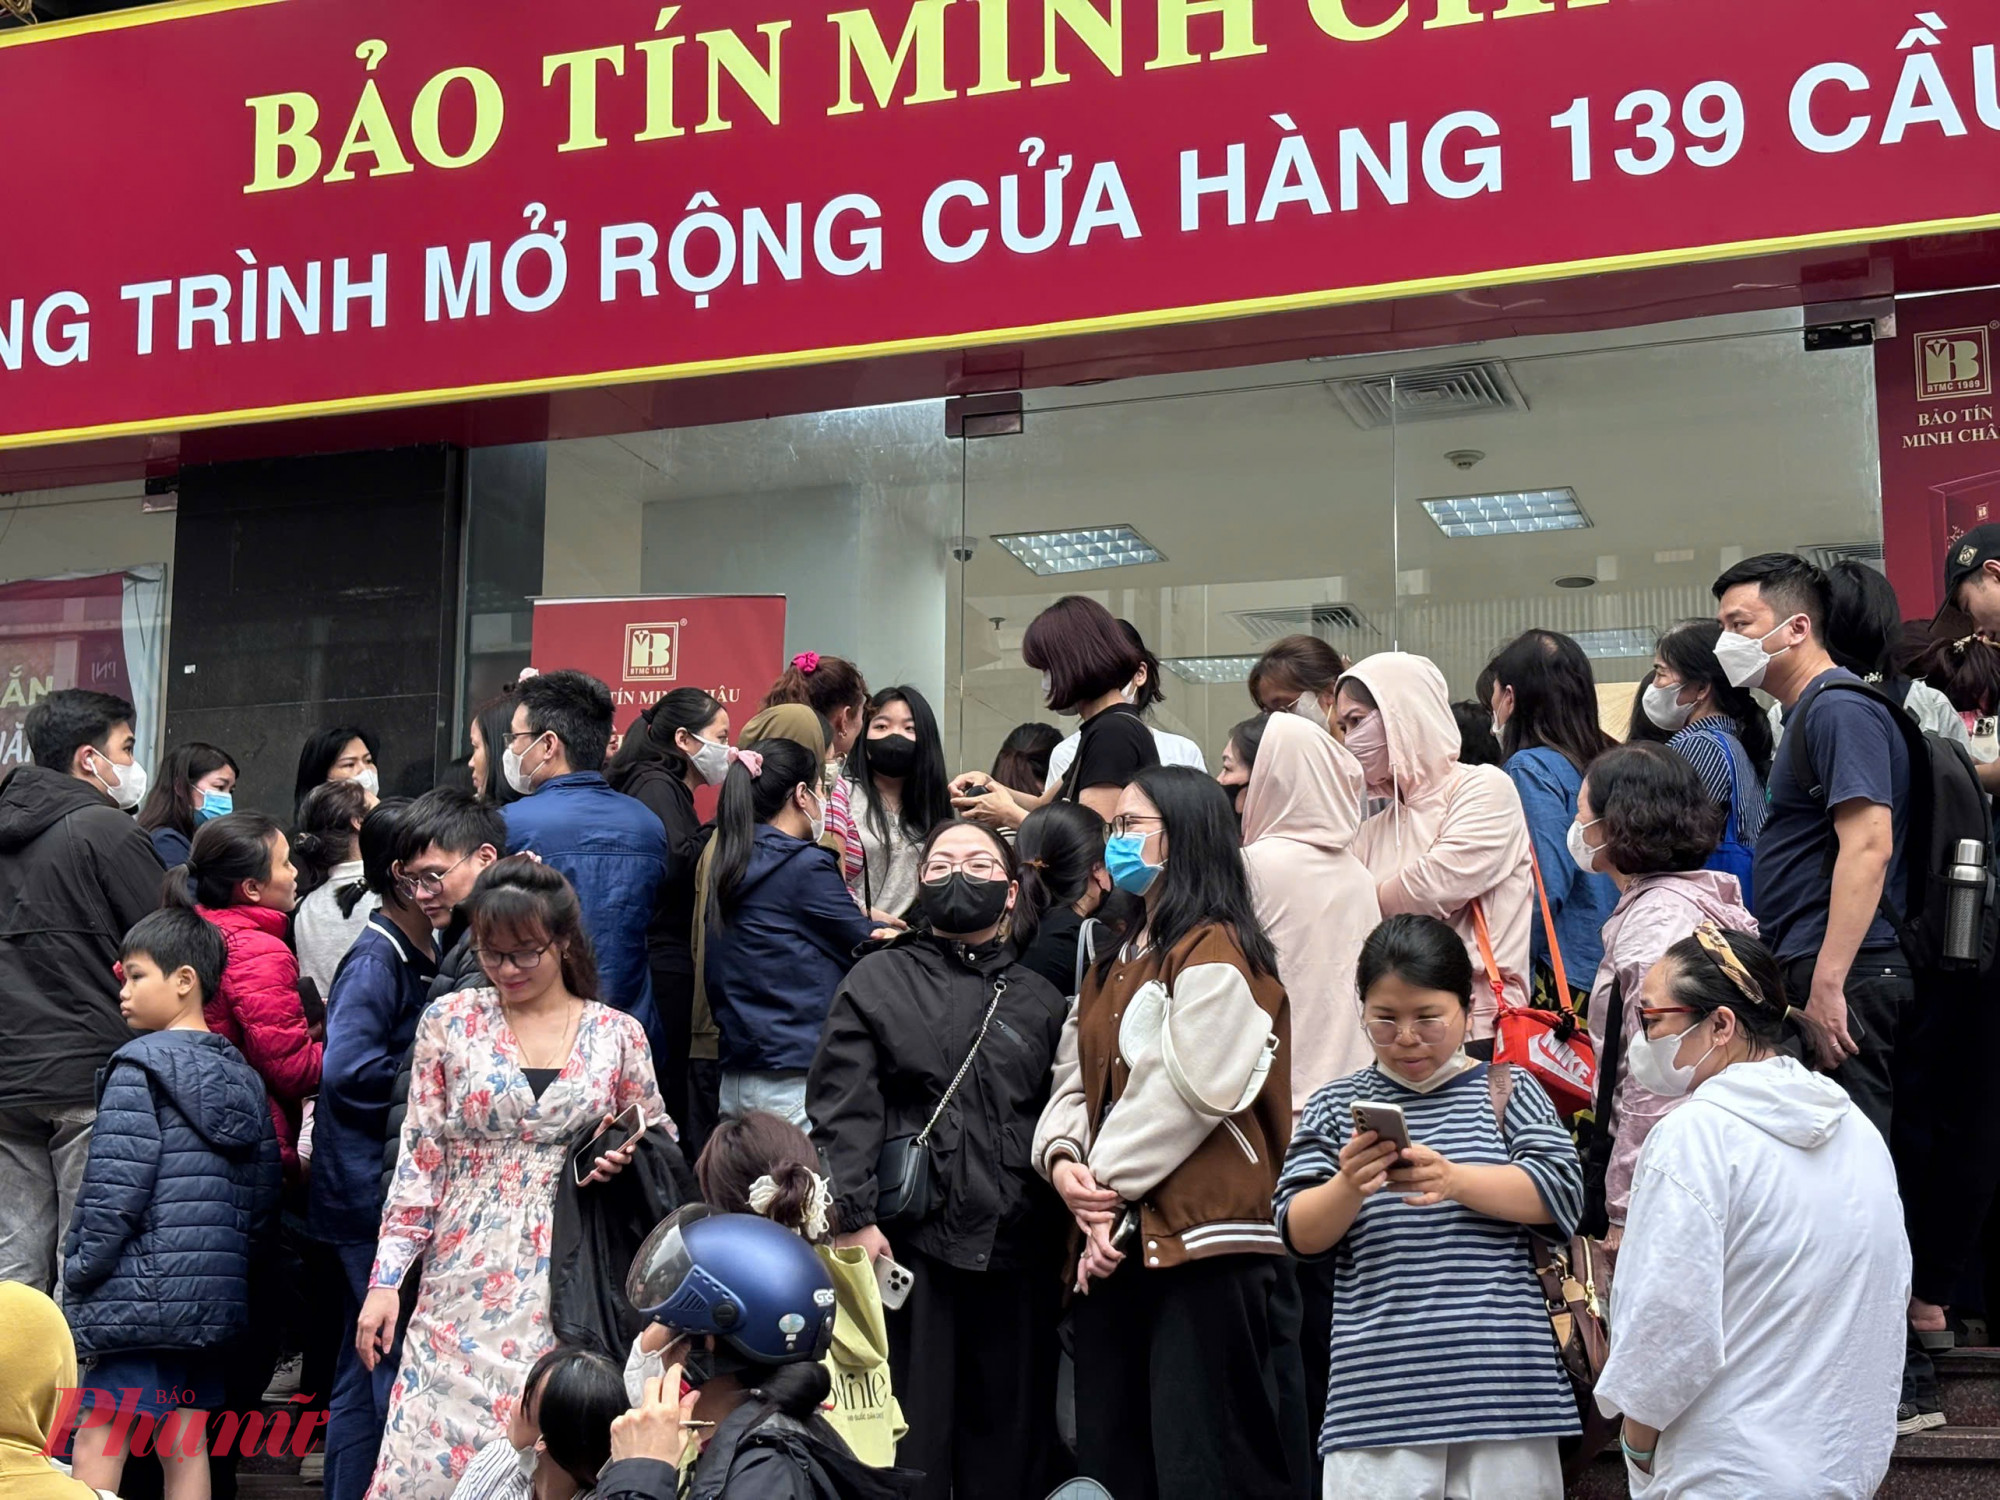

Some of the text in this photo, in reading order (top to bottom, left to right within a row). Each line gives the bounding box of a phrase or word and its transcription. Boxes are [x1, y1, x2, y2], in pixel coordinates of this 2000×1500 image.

[243, 0, 1268, 194] BẢO TÍN MINH
[121, 248, 388, 355] TRÌNH
[425, 201, 568, 322] MỞ
[601, 191, 884, 309] RỘNG
[922, 137, 1143, 264] CỬA
[1180, 110, 1503, 232] HÀNG
[1551, 80, 1745, 182] 139
[1927, 379, 1981, 393] BTMC 1989
[1918, 404, 1993, 427] BẢO TÍN
[1902, 423, 2000, 449] MINH CHÂ
[1539, 1027, 1592, 1079] NIKE
